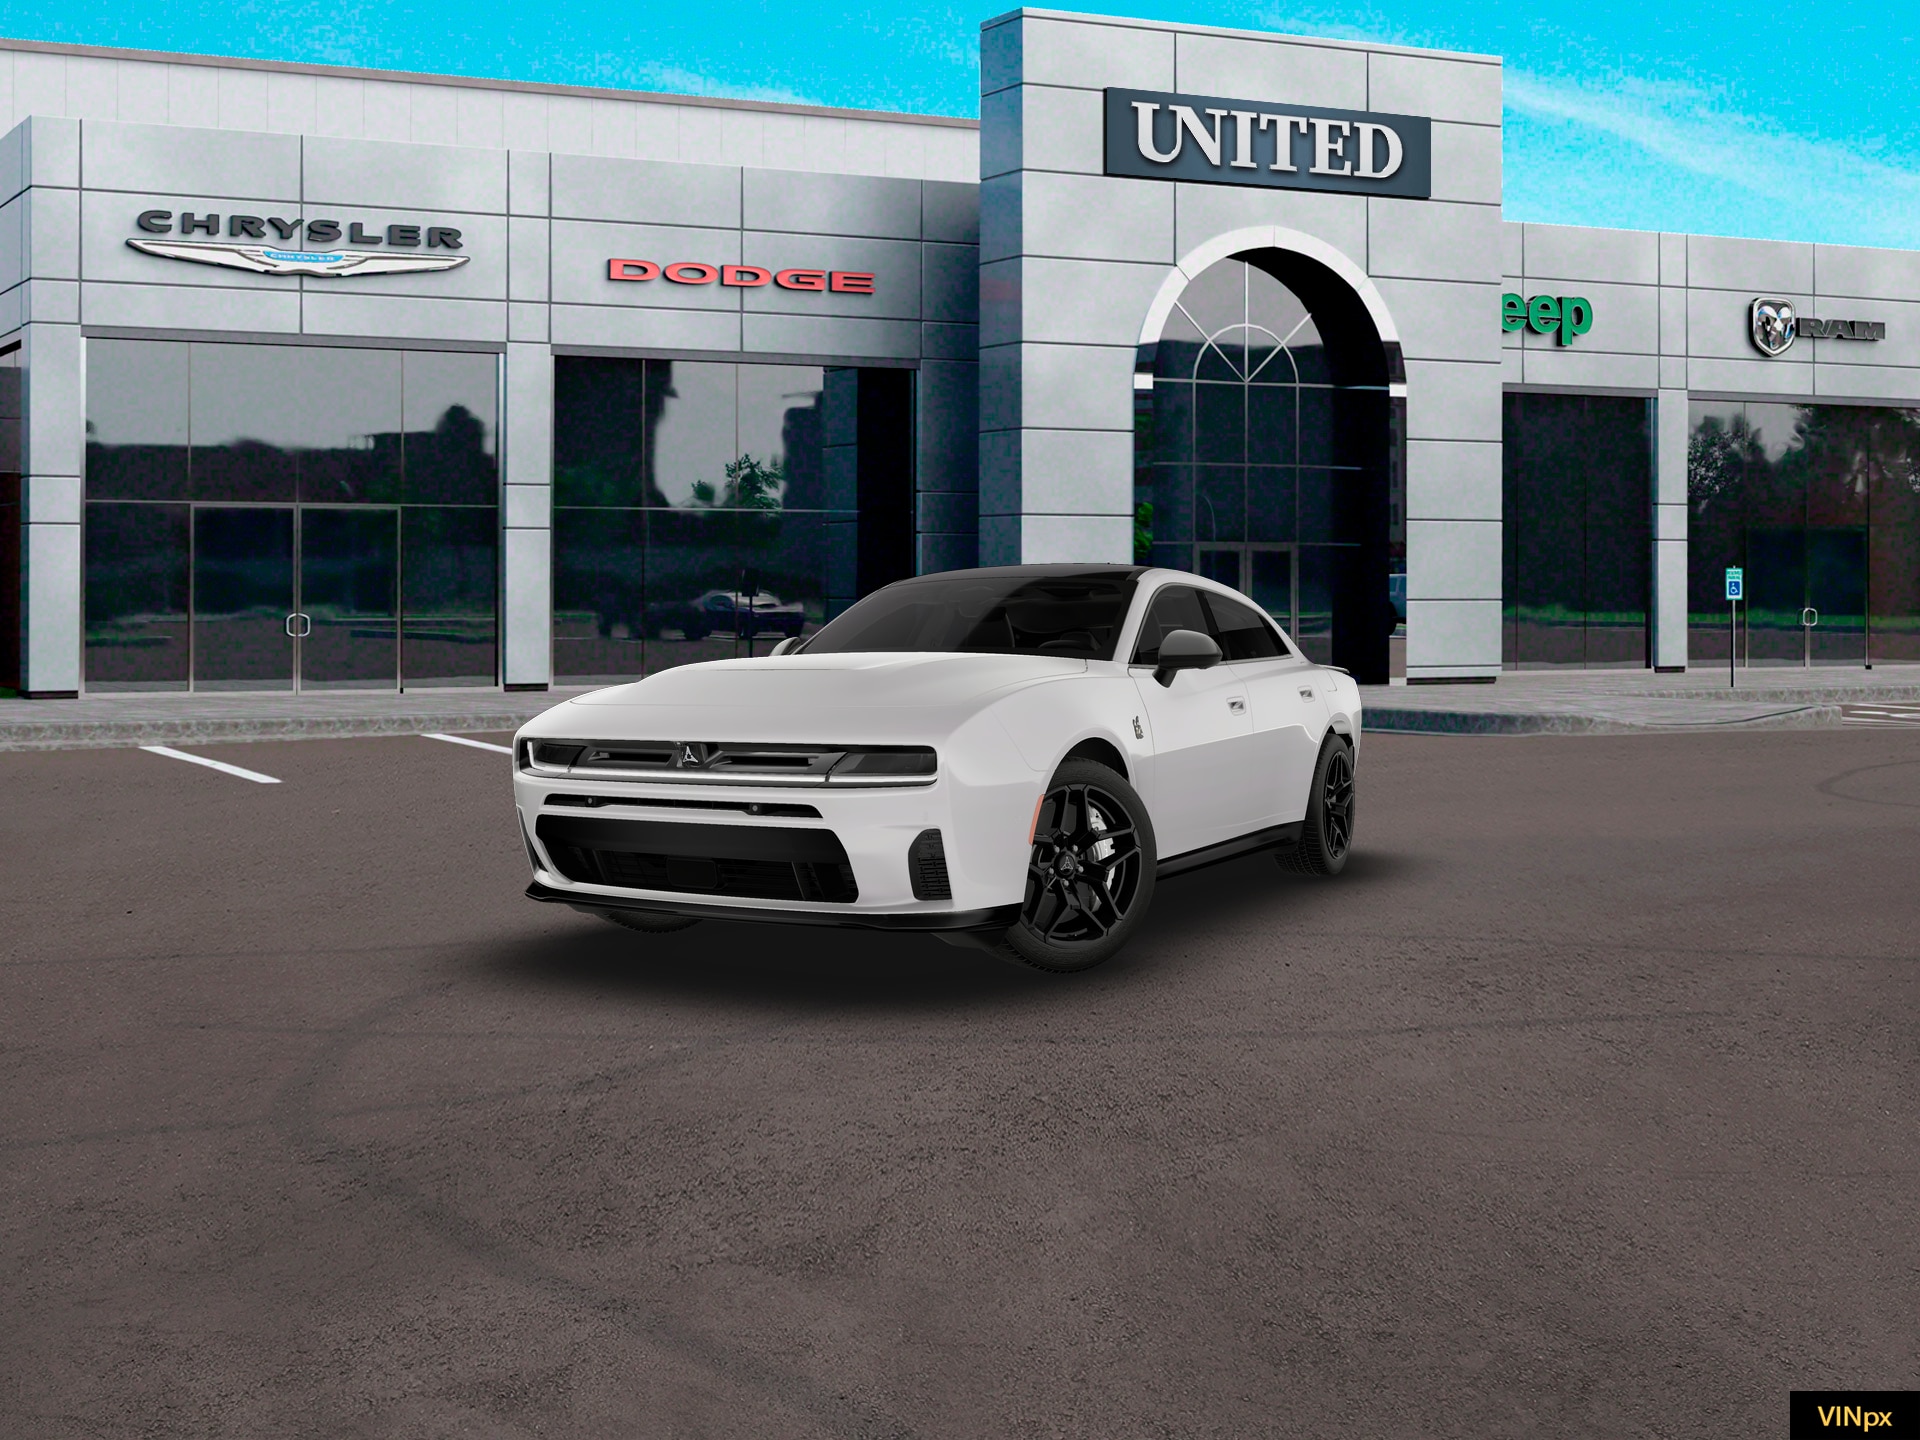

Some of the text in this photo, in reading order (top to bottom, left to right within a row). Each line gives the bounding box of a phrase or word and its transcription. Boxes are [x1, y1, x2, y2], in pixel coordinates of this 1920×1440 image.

[1131, 101, 1403, 179] UNITED
[137, 209, 463, 249] CHRYSLER
[608, 258, 876, 293] DODGE
[1502, 292, 1593, 346] eep
[1797, 317, 1885, 341] RAM
